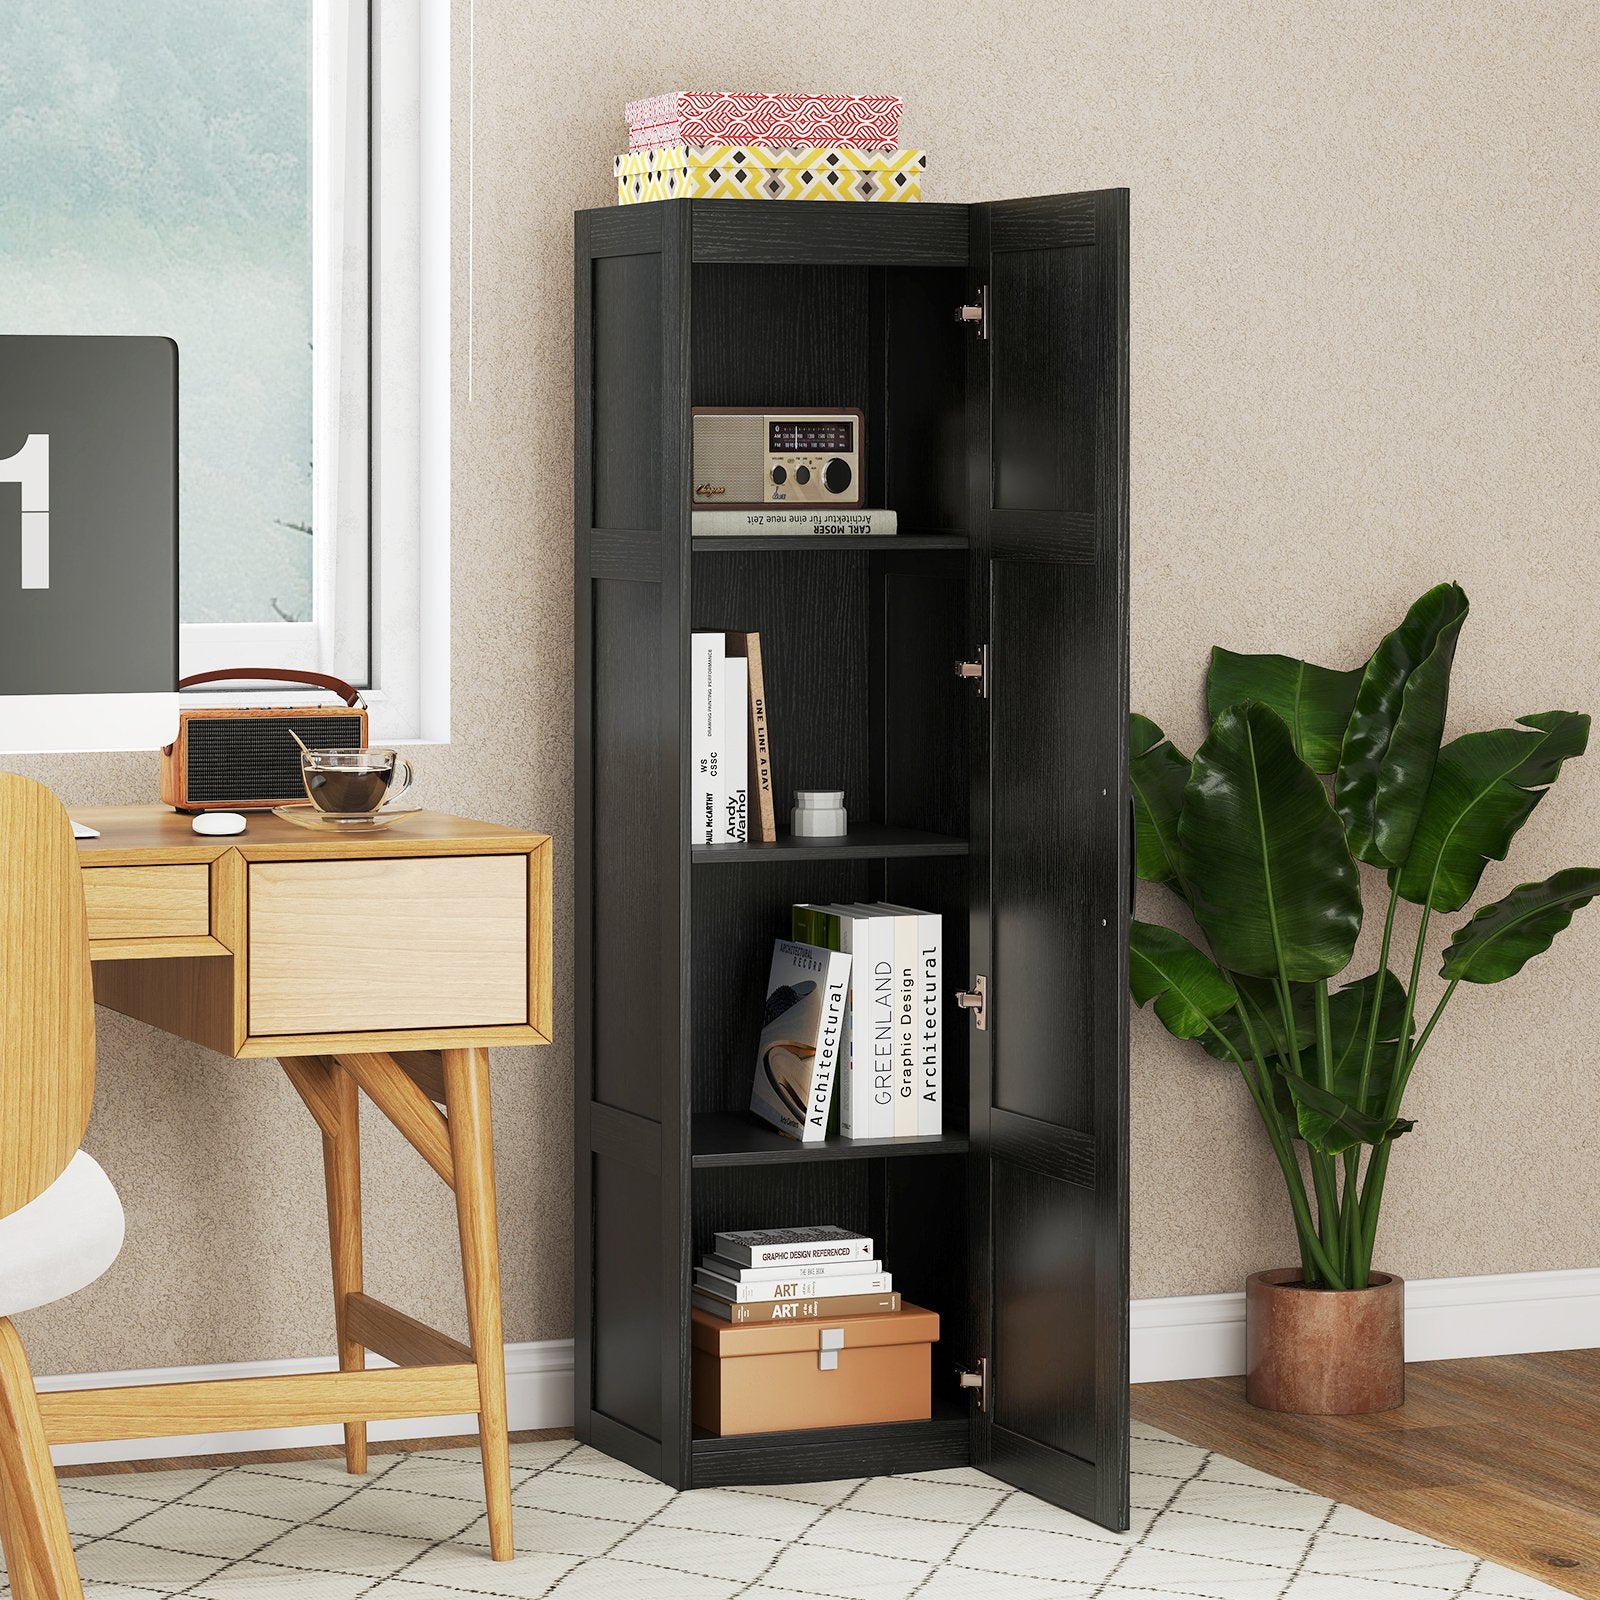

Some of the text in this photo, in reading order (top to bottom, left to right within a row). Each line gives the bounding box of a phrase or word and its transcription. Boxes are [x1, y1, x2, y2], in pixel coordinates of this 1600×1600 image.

[0, 433, 50, 590] 1
[809, 515, 822, 524] für
[824, 515, 872, 524] Architektur
[747, 515, 764, 525] Zeit
[789, 515, 806, 525] eine
[814, 525, 871, 534] CARL MOSER
[758, 728, 766, 752] LINE
[700, 759, 708, 772] WS
[761, 769, 769, 791] DAY
[726, 796, 738, 838] Andy
[736, 790, 746, 843] Warhol
[793, 956, 822, 972] RECORD
[922, 946, 936, 1102] Architectural
[875, 962, 892, 1104] GREENLAND
[901, 968, 914, 1097] Graphic Design
[810, 983, 844, 1126] Architectural
[762, 1252, 789, 1260] GRAPHIC
[790, 1250, 811, 1259] DESIGN
[812, 1248, 850, 1258] REFERENCED
[774, 1283, 798, 1298] ART
[772, 1303, 800, 1318] ART
